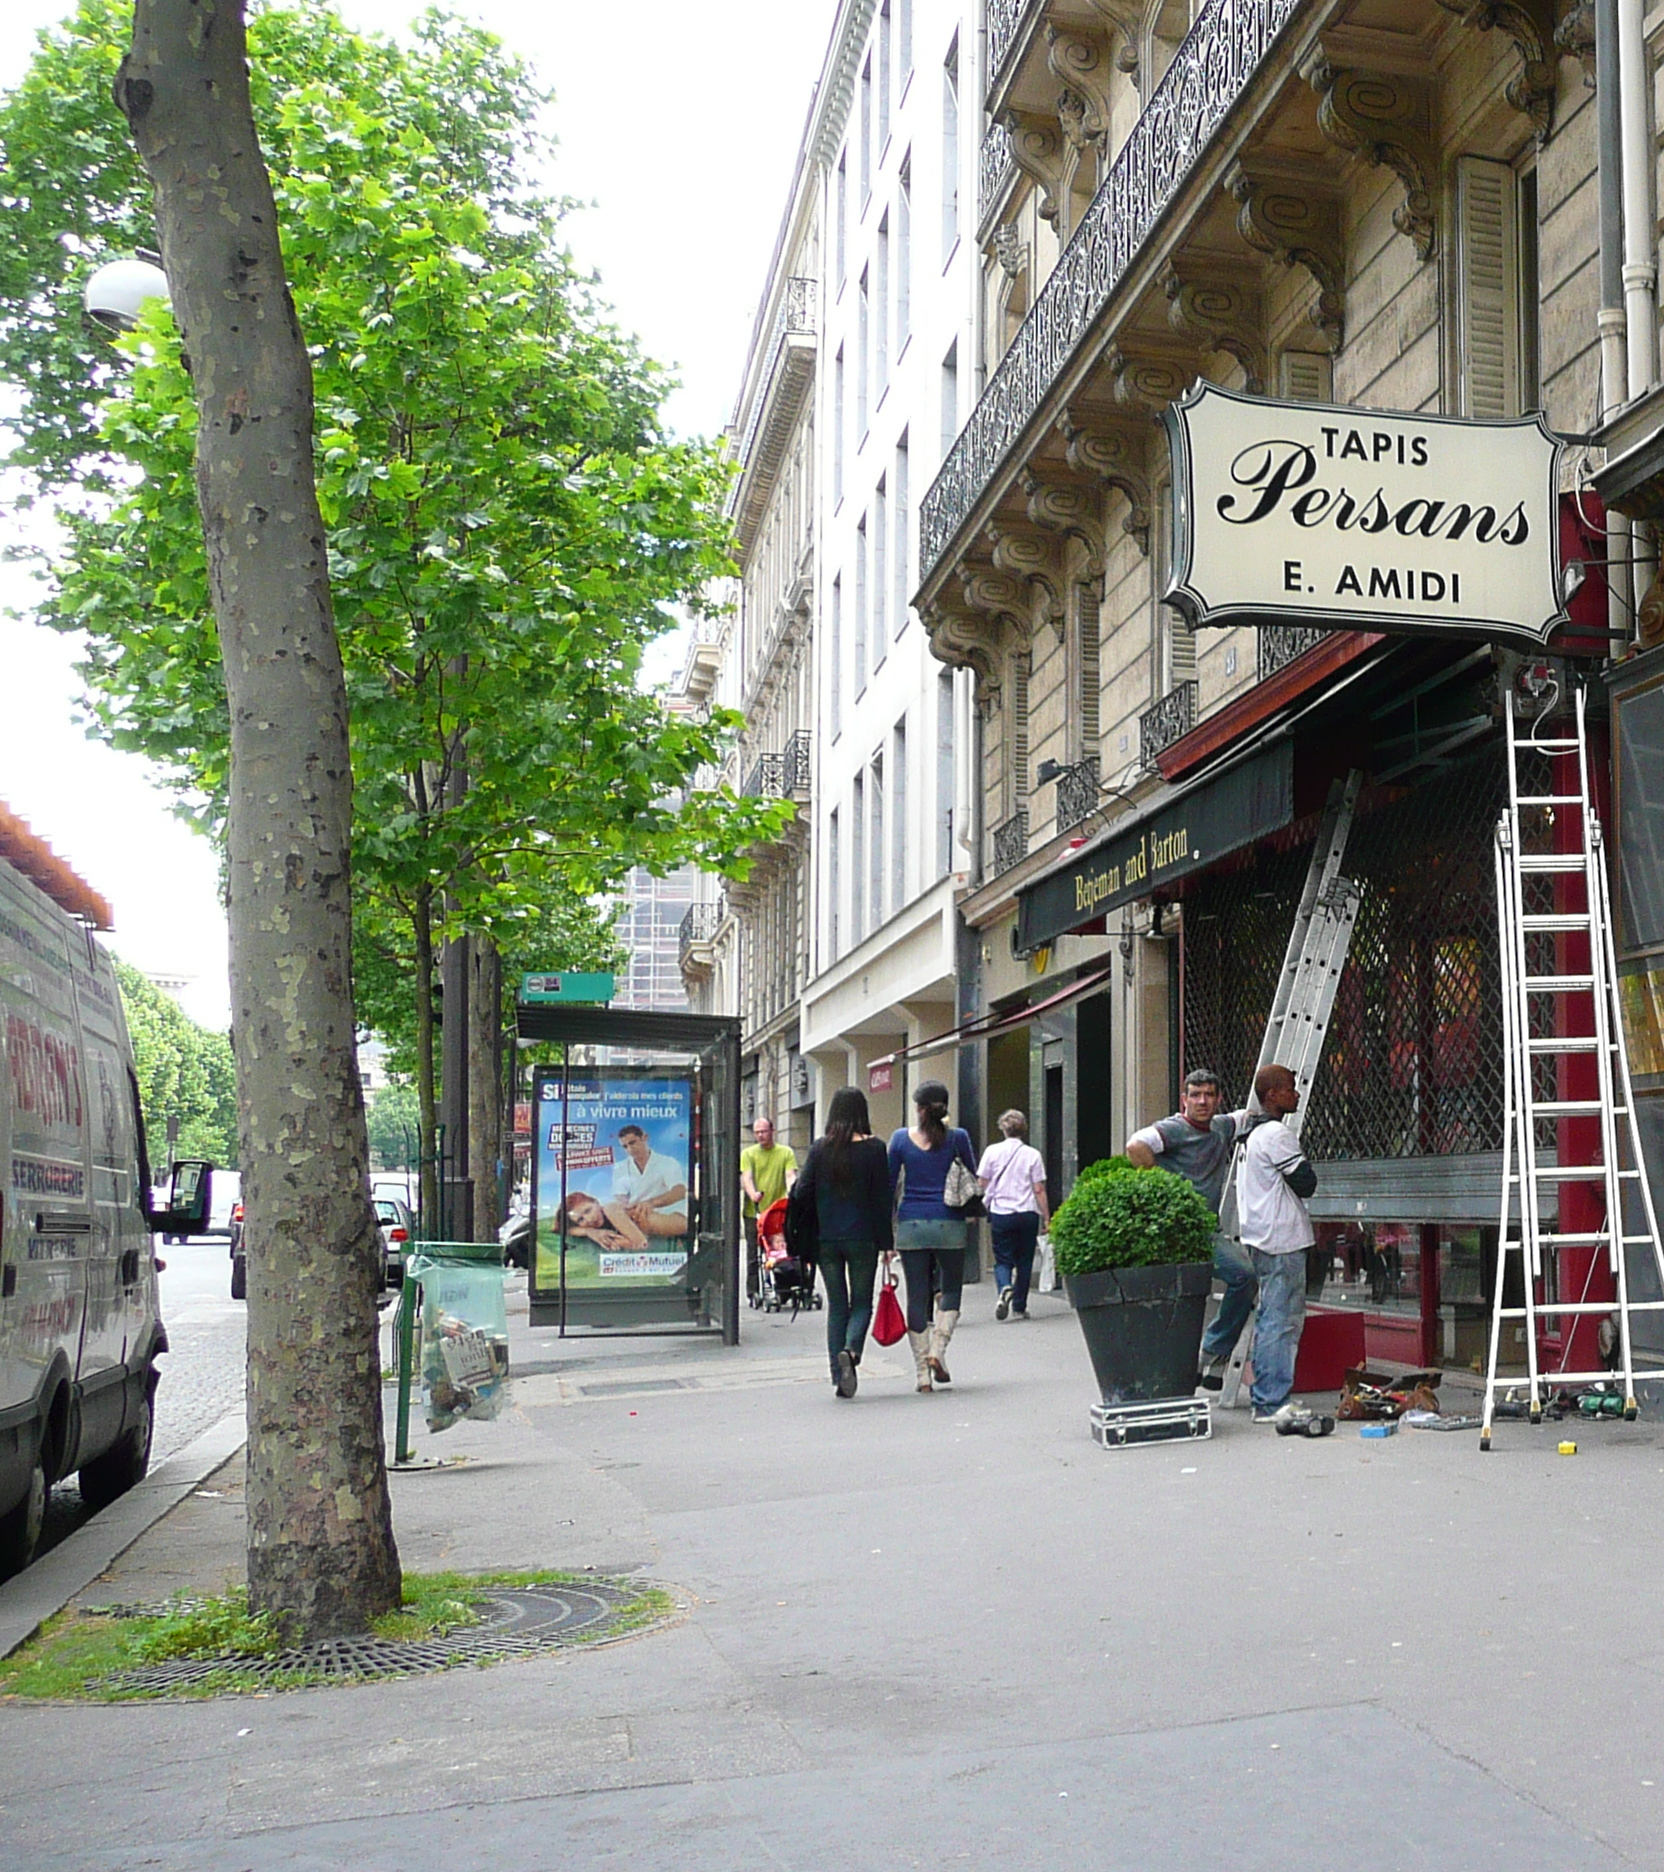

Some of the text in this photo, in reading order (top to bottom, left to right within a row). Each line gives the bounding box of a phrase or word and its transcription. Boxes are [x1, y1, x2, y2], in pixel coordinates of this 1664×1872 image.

[1321, 427, 1428, 466] TAPIS
[1216, 439, 1530, 546] Persans
[1283, 560, 1461, 603] E. AMIDI
[1125, 836, 1146, 887] and
[576, 1104, 678, 1118] à vivre mieux
[12, 1159, 85, 1196] SERRURERIE
[602, 1255, 686, 1267] Crédit Mutuel
